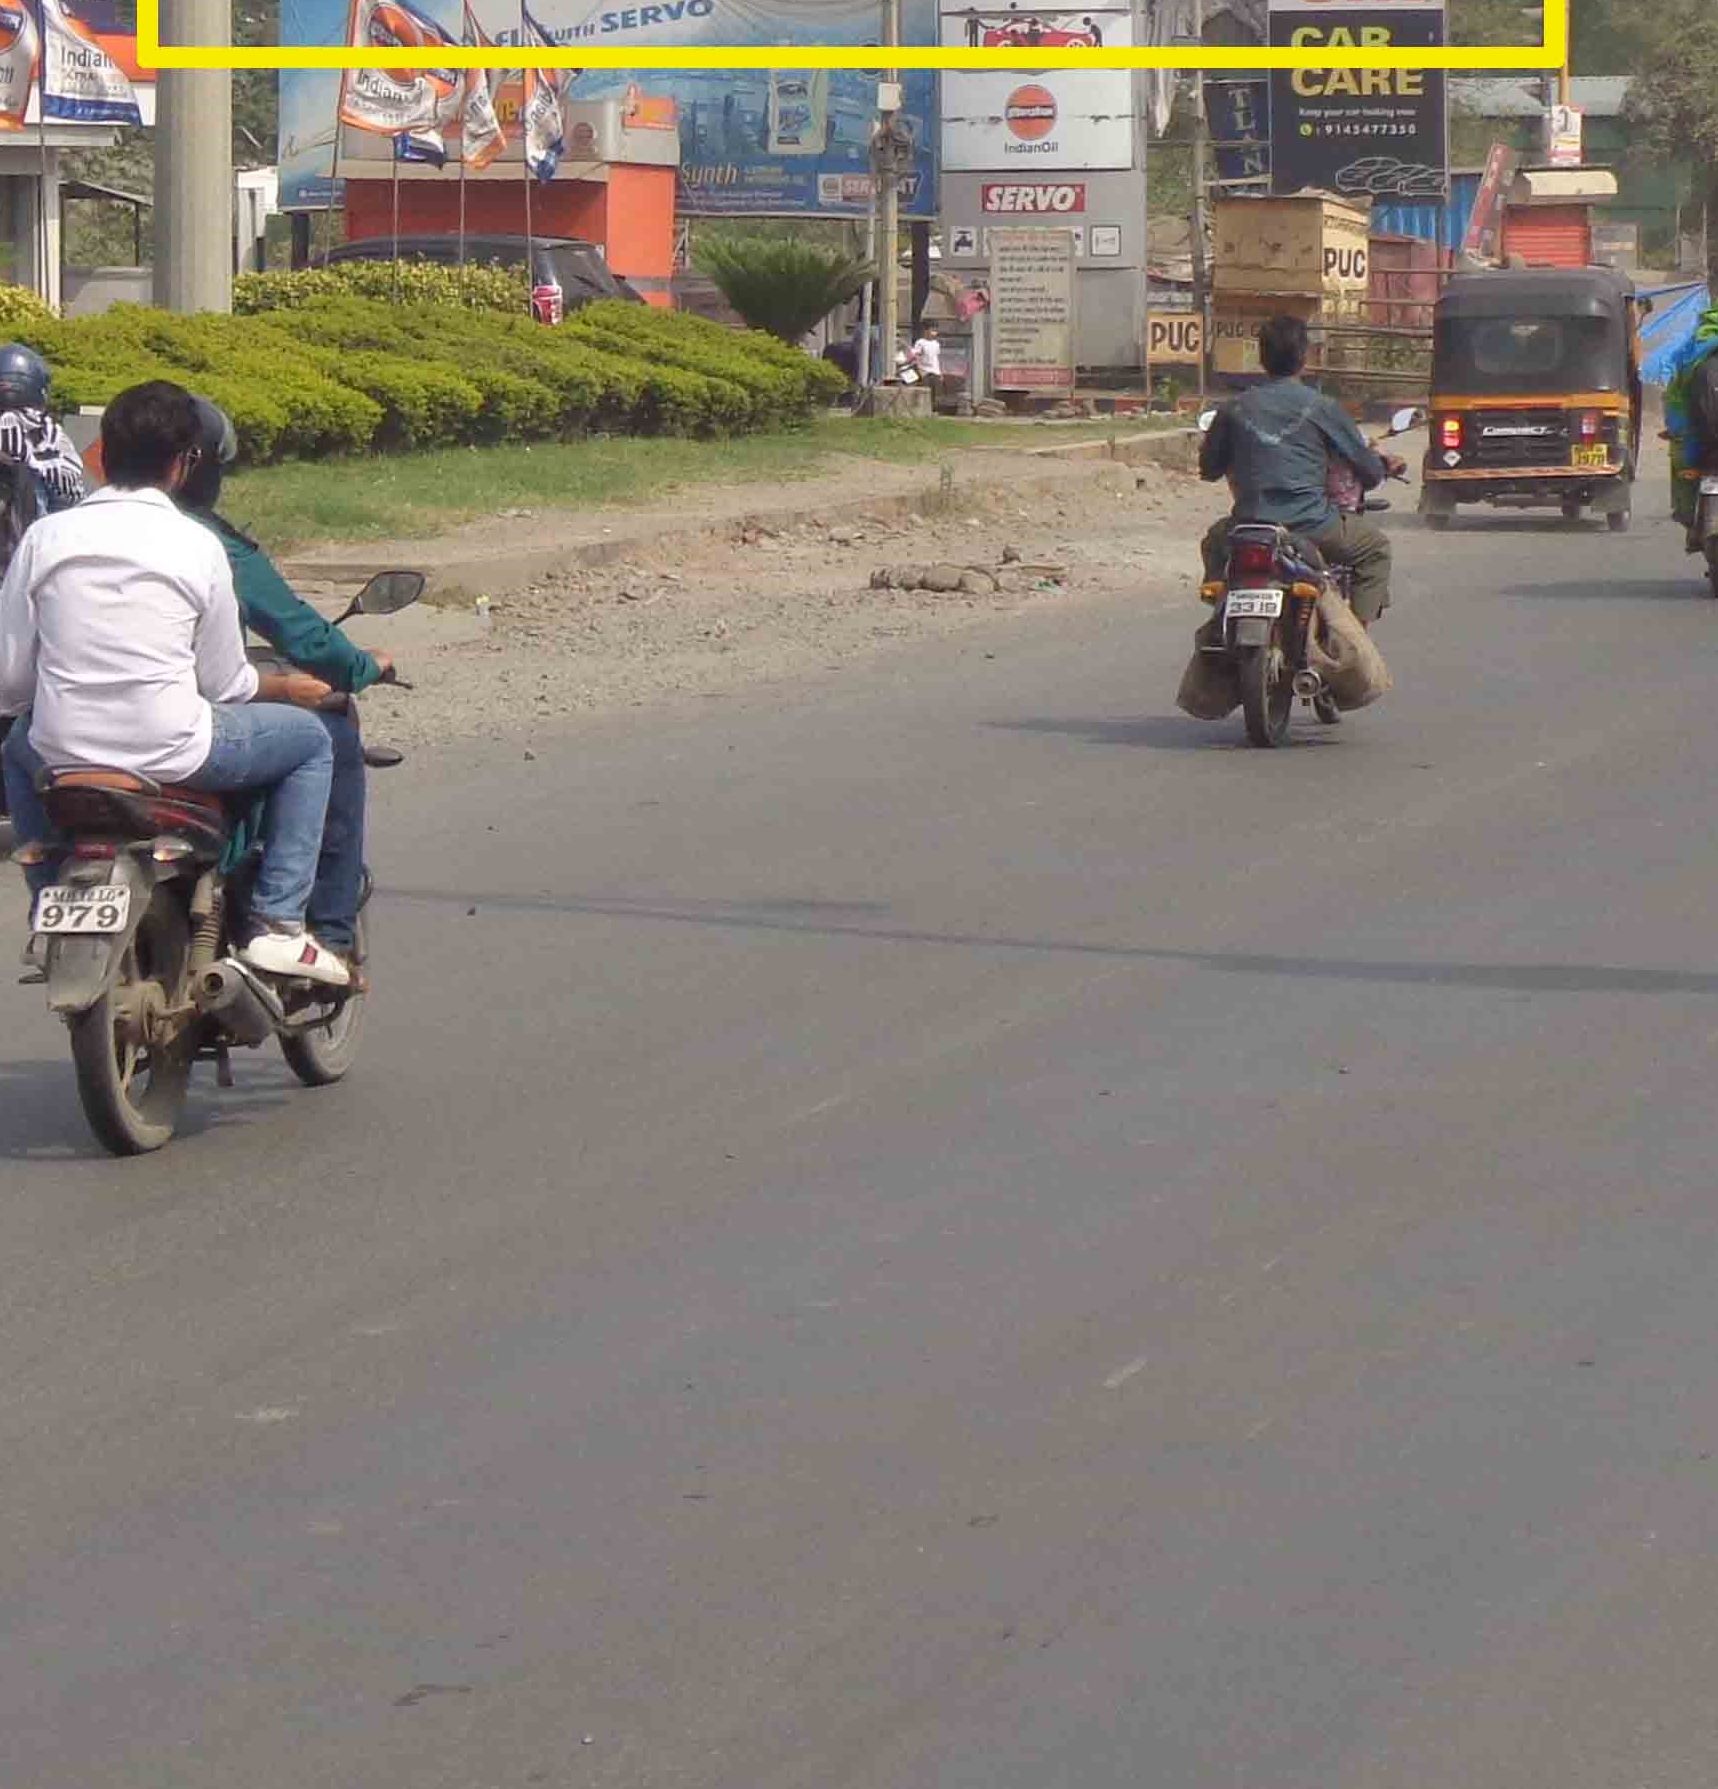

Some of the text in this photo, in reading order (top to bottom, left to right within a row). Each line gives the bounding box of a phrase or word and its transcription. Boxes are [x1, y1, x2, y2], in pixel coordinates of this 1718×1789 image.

[1290, 67, 1424, 97] CARE
[1004, 141, 1059, 154] IndianOil
[986, 185, 1076, 211] SERVO
[1323, 247, 1367, 280] PUC
[1150, 321, 1200, 353] PUC
[42, 905, 120, 928] 979
